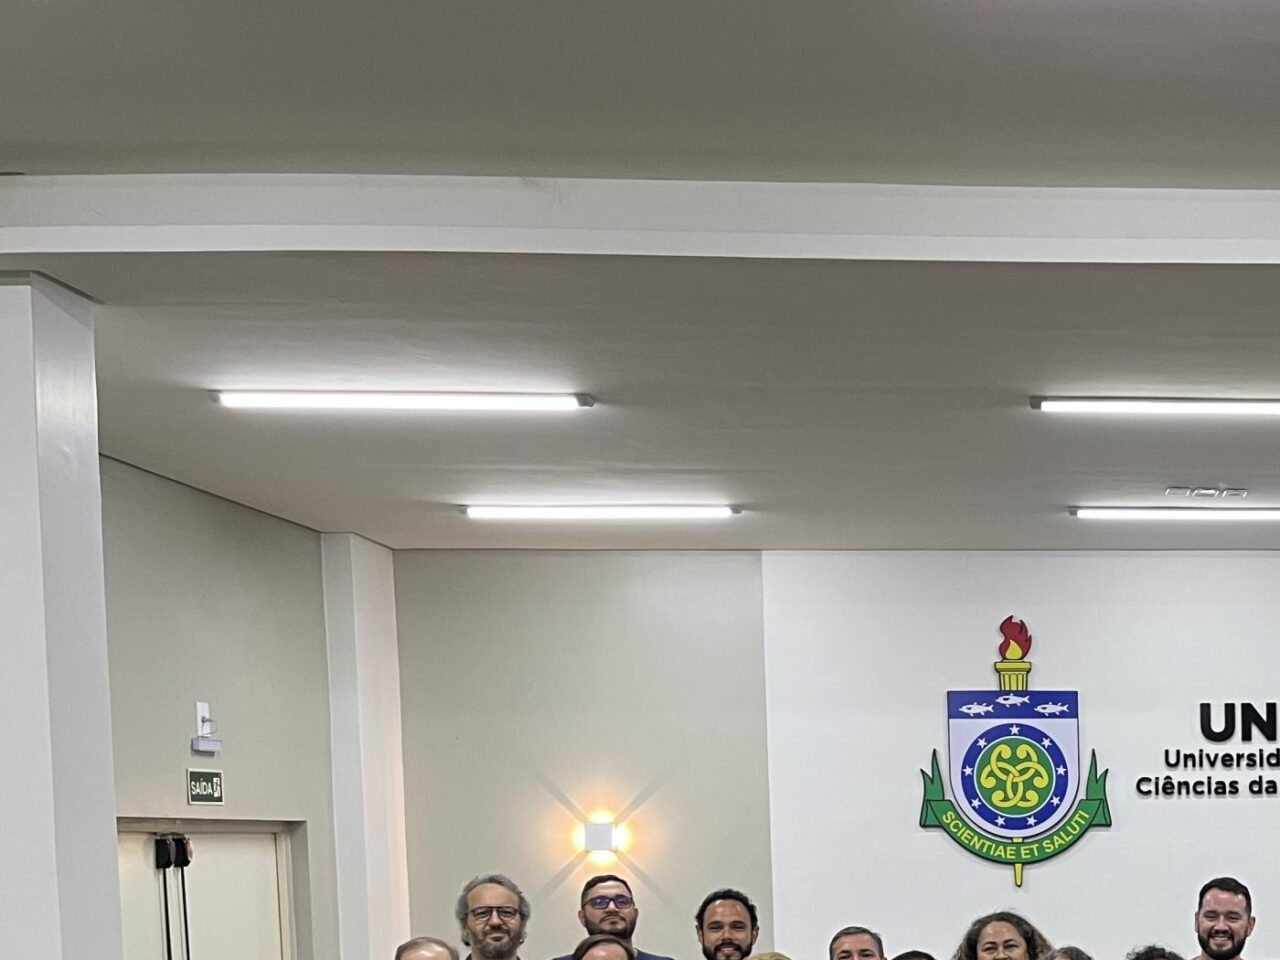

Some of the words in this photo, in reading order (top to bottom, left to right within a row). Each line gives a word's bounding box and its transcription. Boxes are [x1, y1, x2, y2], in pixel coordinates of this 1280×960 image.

[191, 778, 213, 795] SAÍDA
[1136, 774, 1240, 796] Ciências
[1249, 775, 1278, 795] da
[942, 810, 1017, 859] SCIENTIAE
[1021, 845, 1040, 859] ET
[1042, 809, 1090, 853] SALUTI
